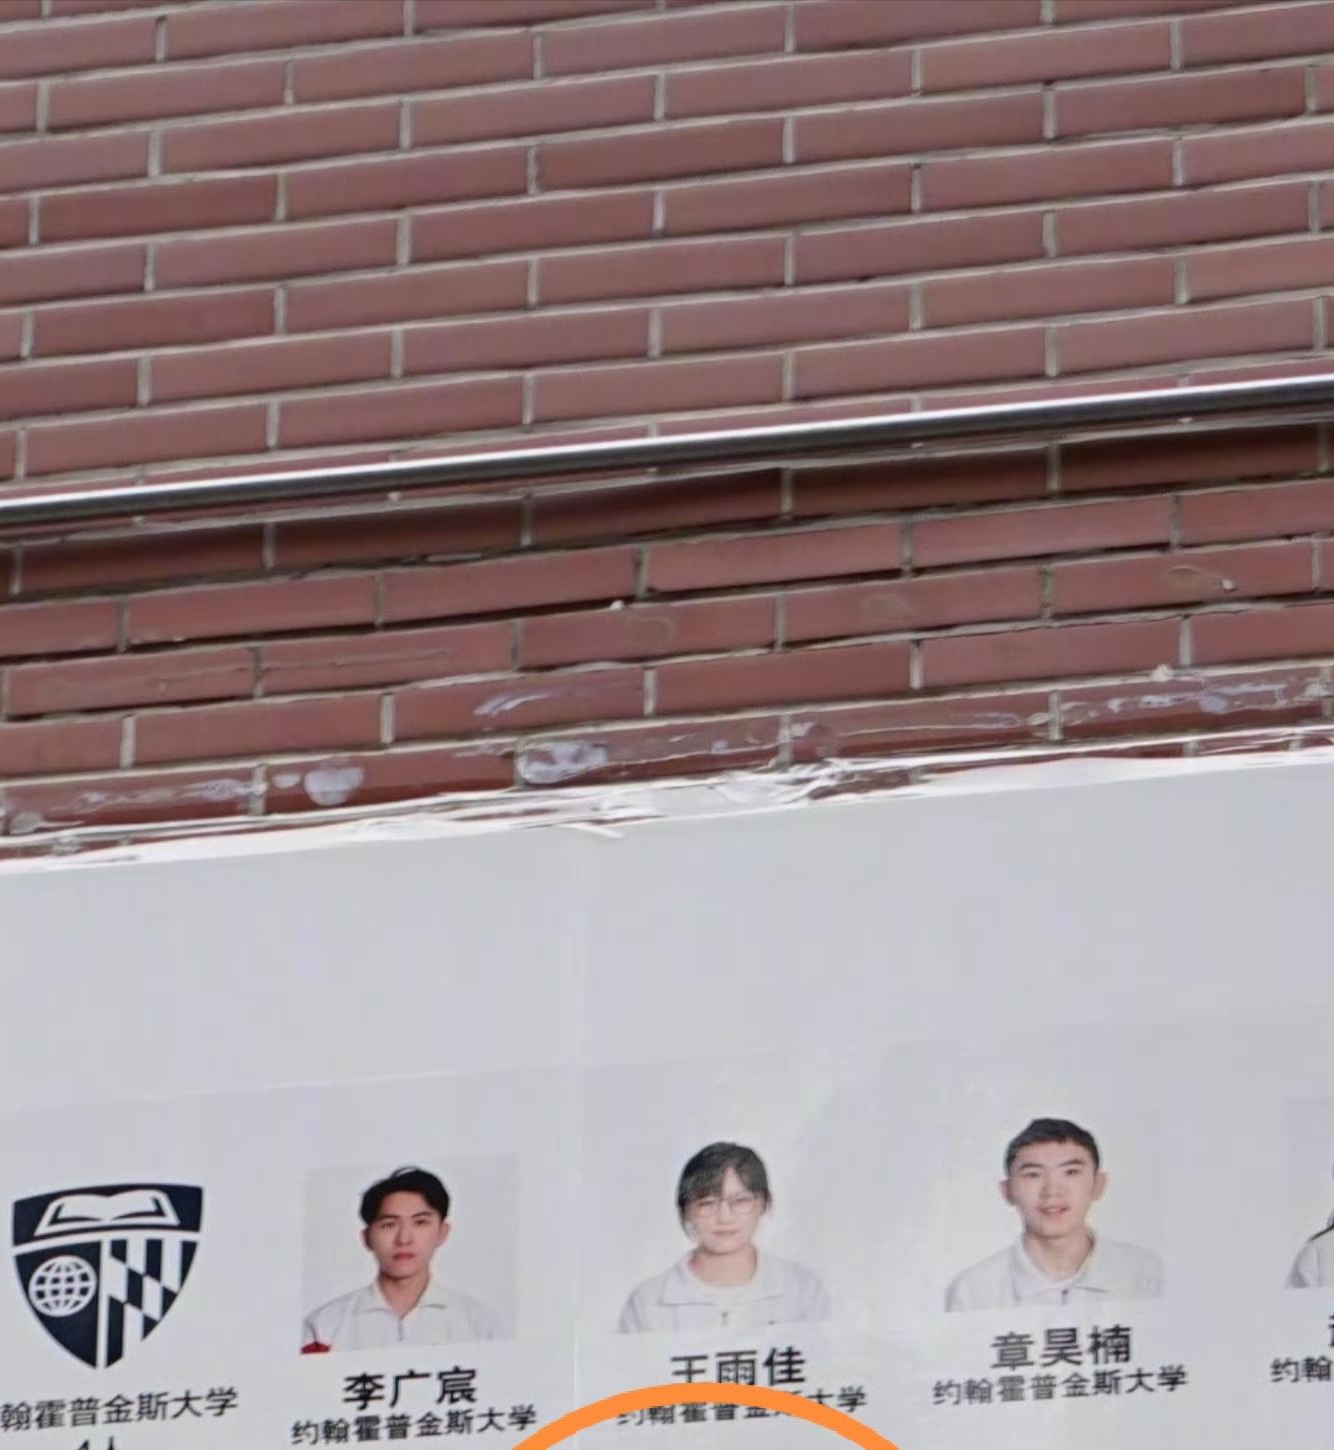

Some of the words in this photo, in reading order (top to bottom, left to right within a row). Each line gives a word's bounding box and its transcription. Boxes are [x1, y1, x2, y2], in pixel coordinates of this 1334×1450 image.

[991, 1323, 1132, 1371] 章昊楠
[933, 1364, 1187, 1405] 约翰霍普金斯大学
[291, 1404, 537, 1446] 约翰霍普金斯大学
